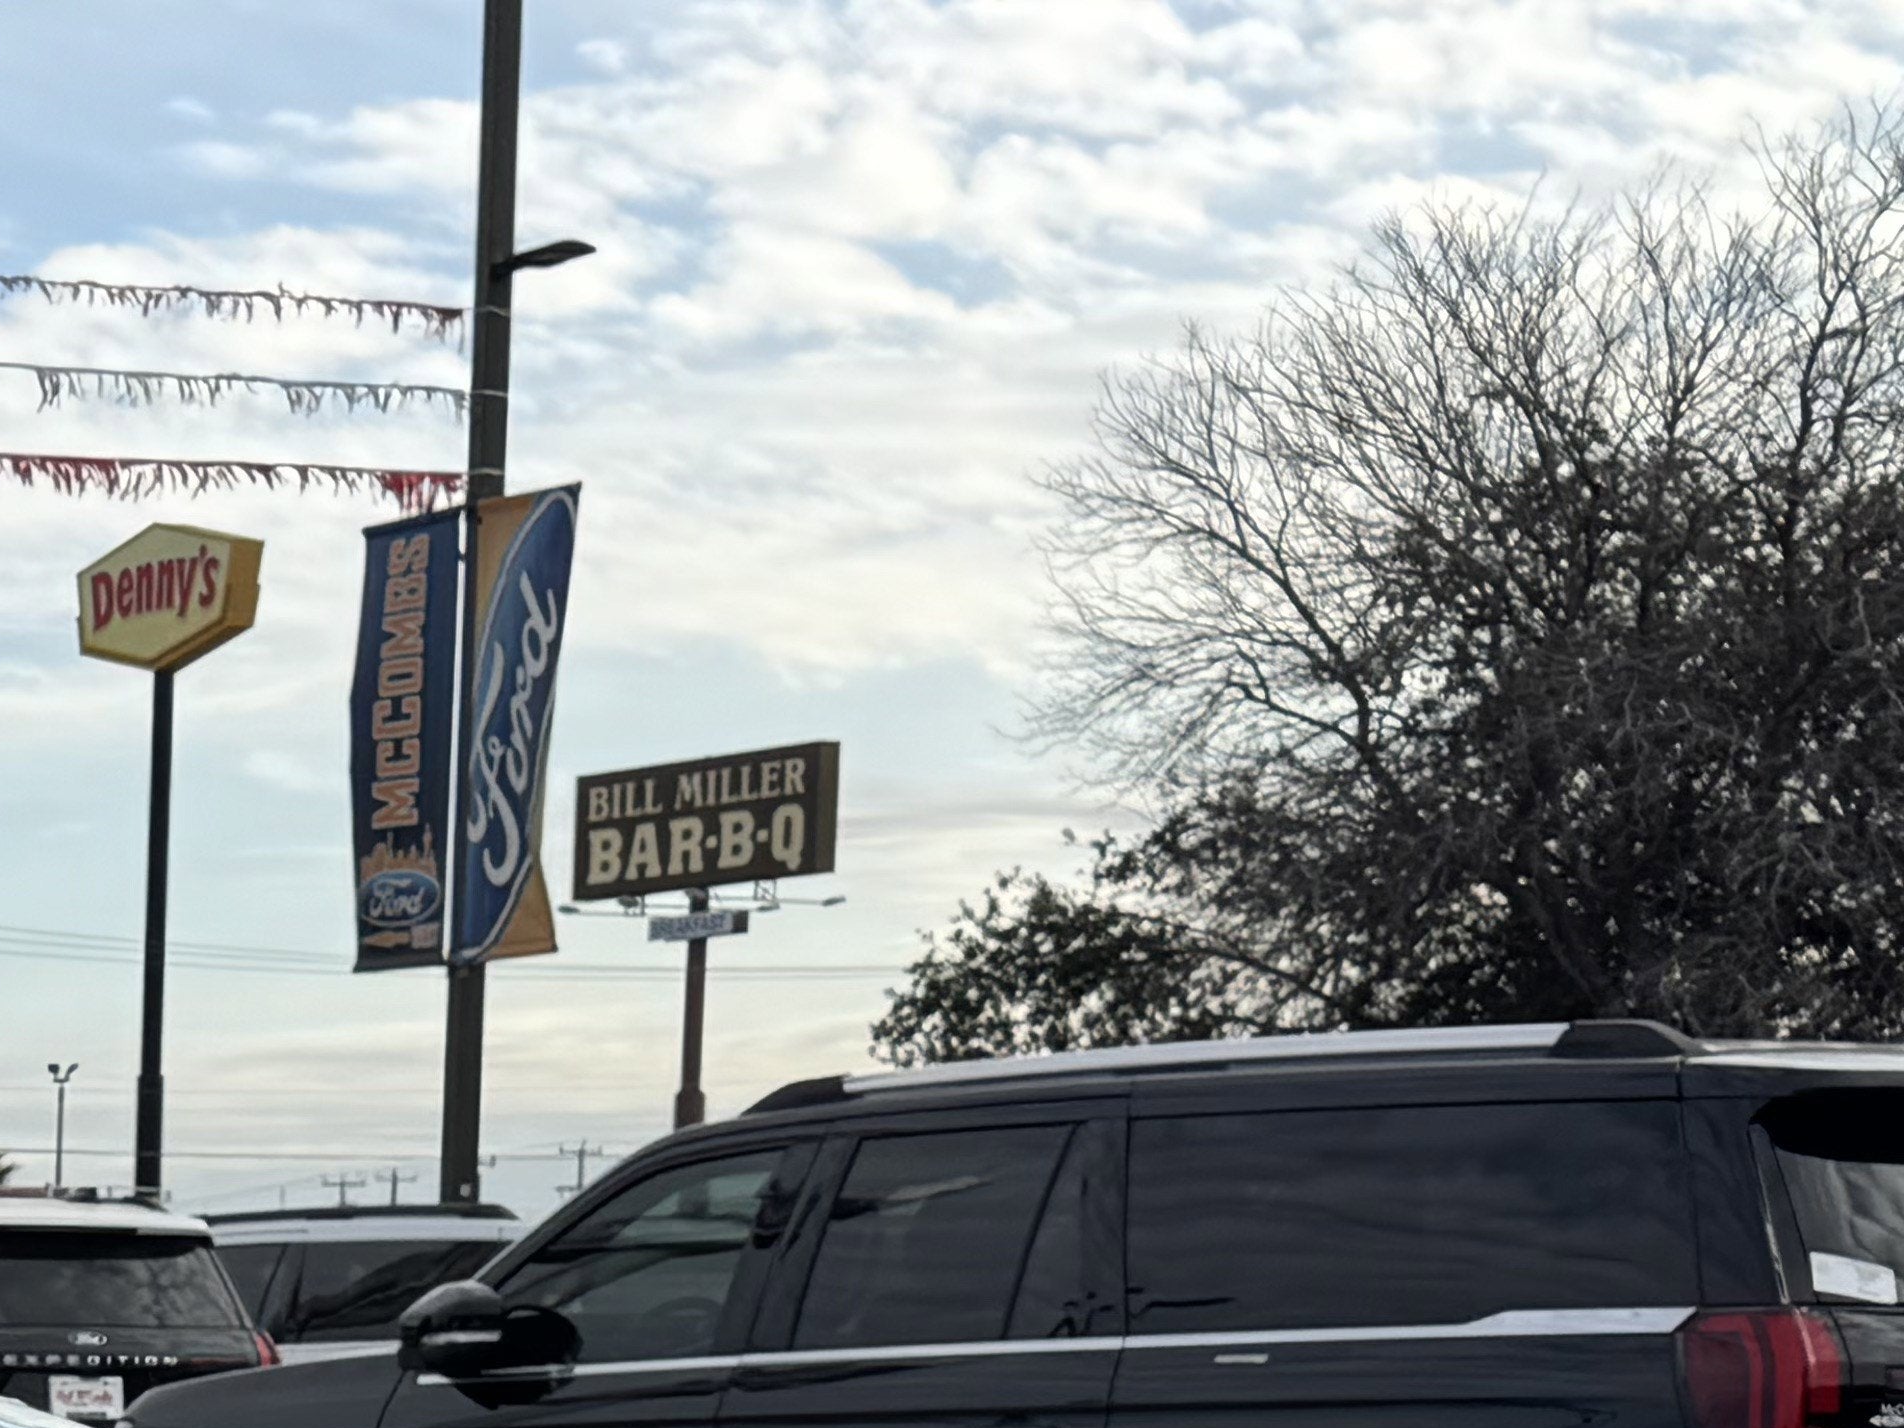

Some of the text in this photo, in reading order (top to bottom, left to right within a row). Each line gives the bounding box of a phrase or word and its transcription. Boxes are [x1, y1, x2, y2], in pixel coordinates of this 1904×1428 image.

[91, 542, 221, 633] Denny's
[466, 569, 558, 888] Ford
[587, 757, 808, 823] BILL MILLER
